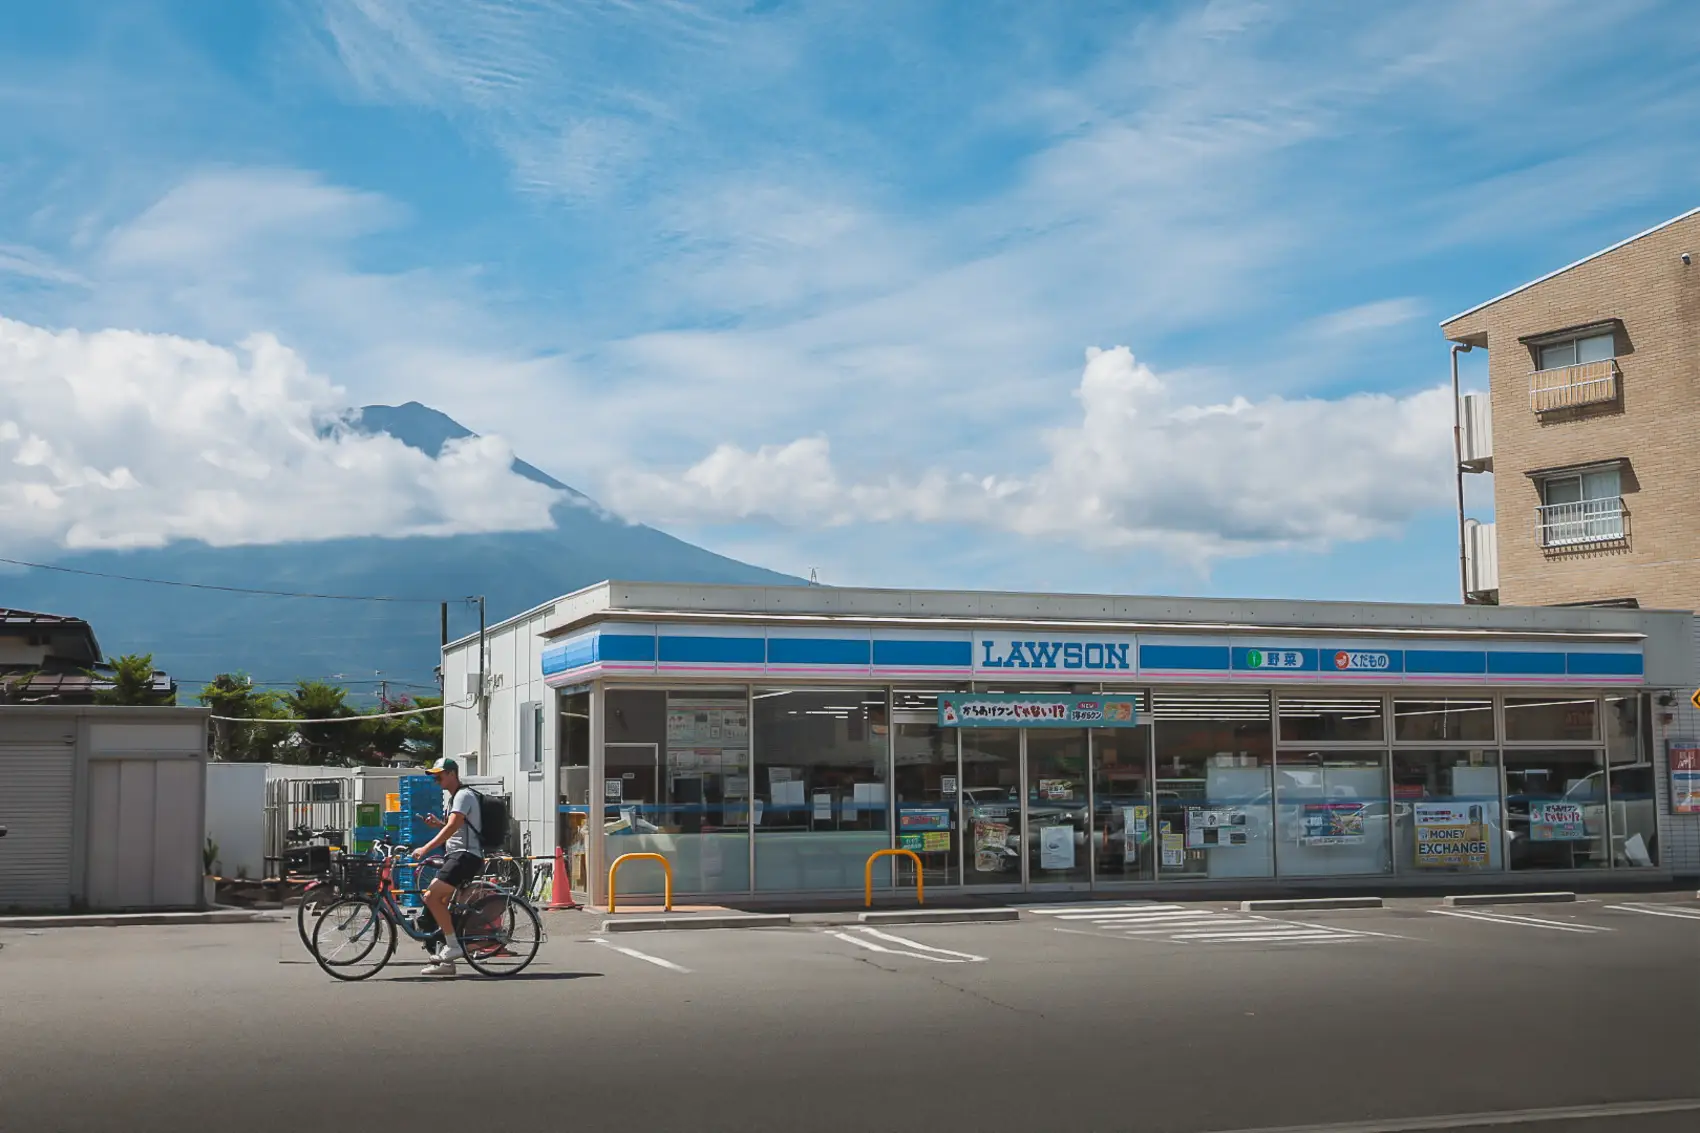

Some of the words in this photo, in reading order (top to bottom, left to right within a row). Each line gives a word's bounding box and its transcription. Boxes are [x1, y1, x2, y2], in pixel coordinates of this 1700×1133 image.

[982, 640, 1130, 669] LAWSON
[1268, 652, 1297, 667] 野菜
[1350, 653, 1387, 668] くだもの
[1429, 829, 1466, 840] MONEY
[1418, 842, 1487, 855] EXCHANGE
